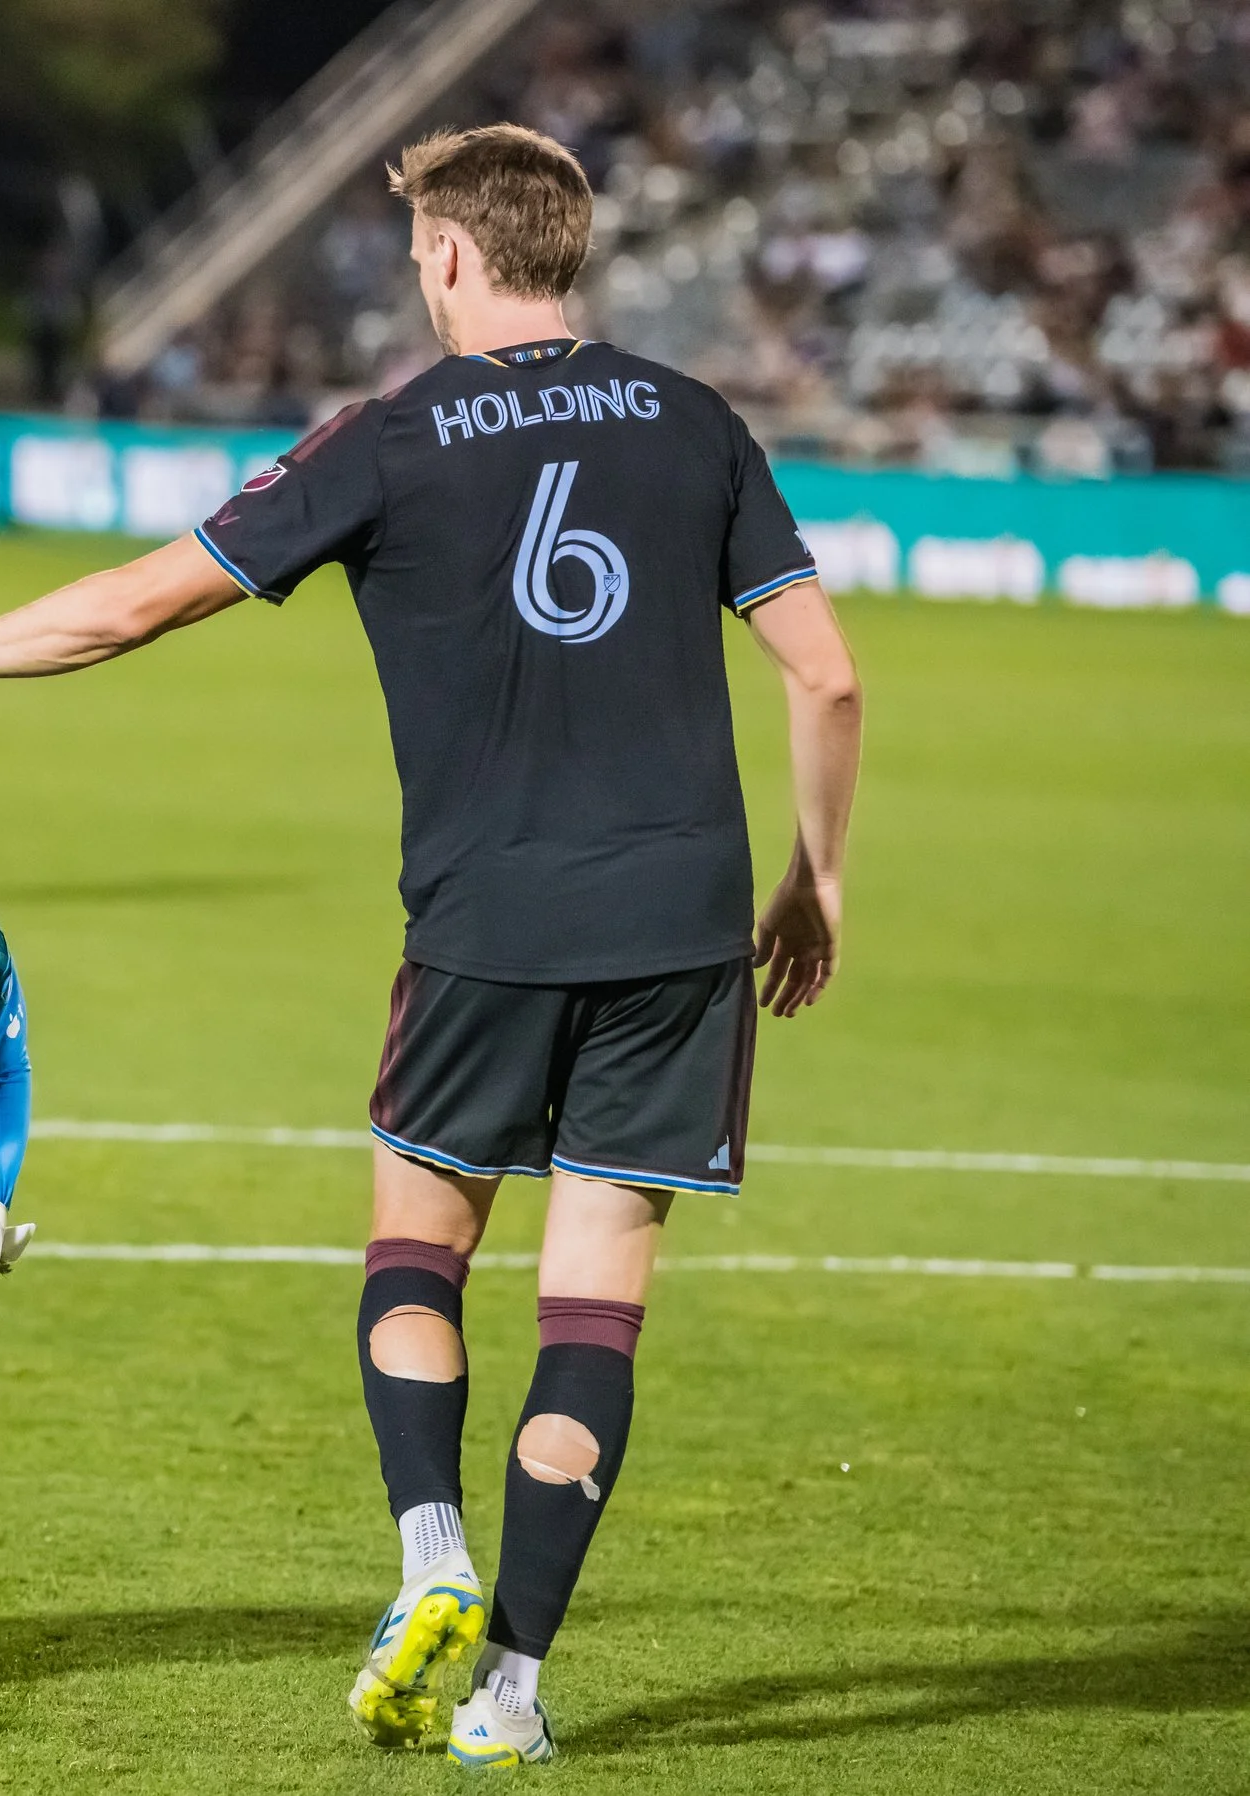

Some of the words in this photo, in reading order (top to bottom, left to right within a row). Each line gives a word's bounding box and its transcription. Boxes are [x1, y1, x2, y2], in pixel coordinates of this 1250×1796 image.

[508, 346, 563, 364] COLORADO
[430, 378, 661, 447] HOLDING
[513, 460, 630, 644] 6
